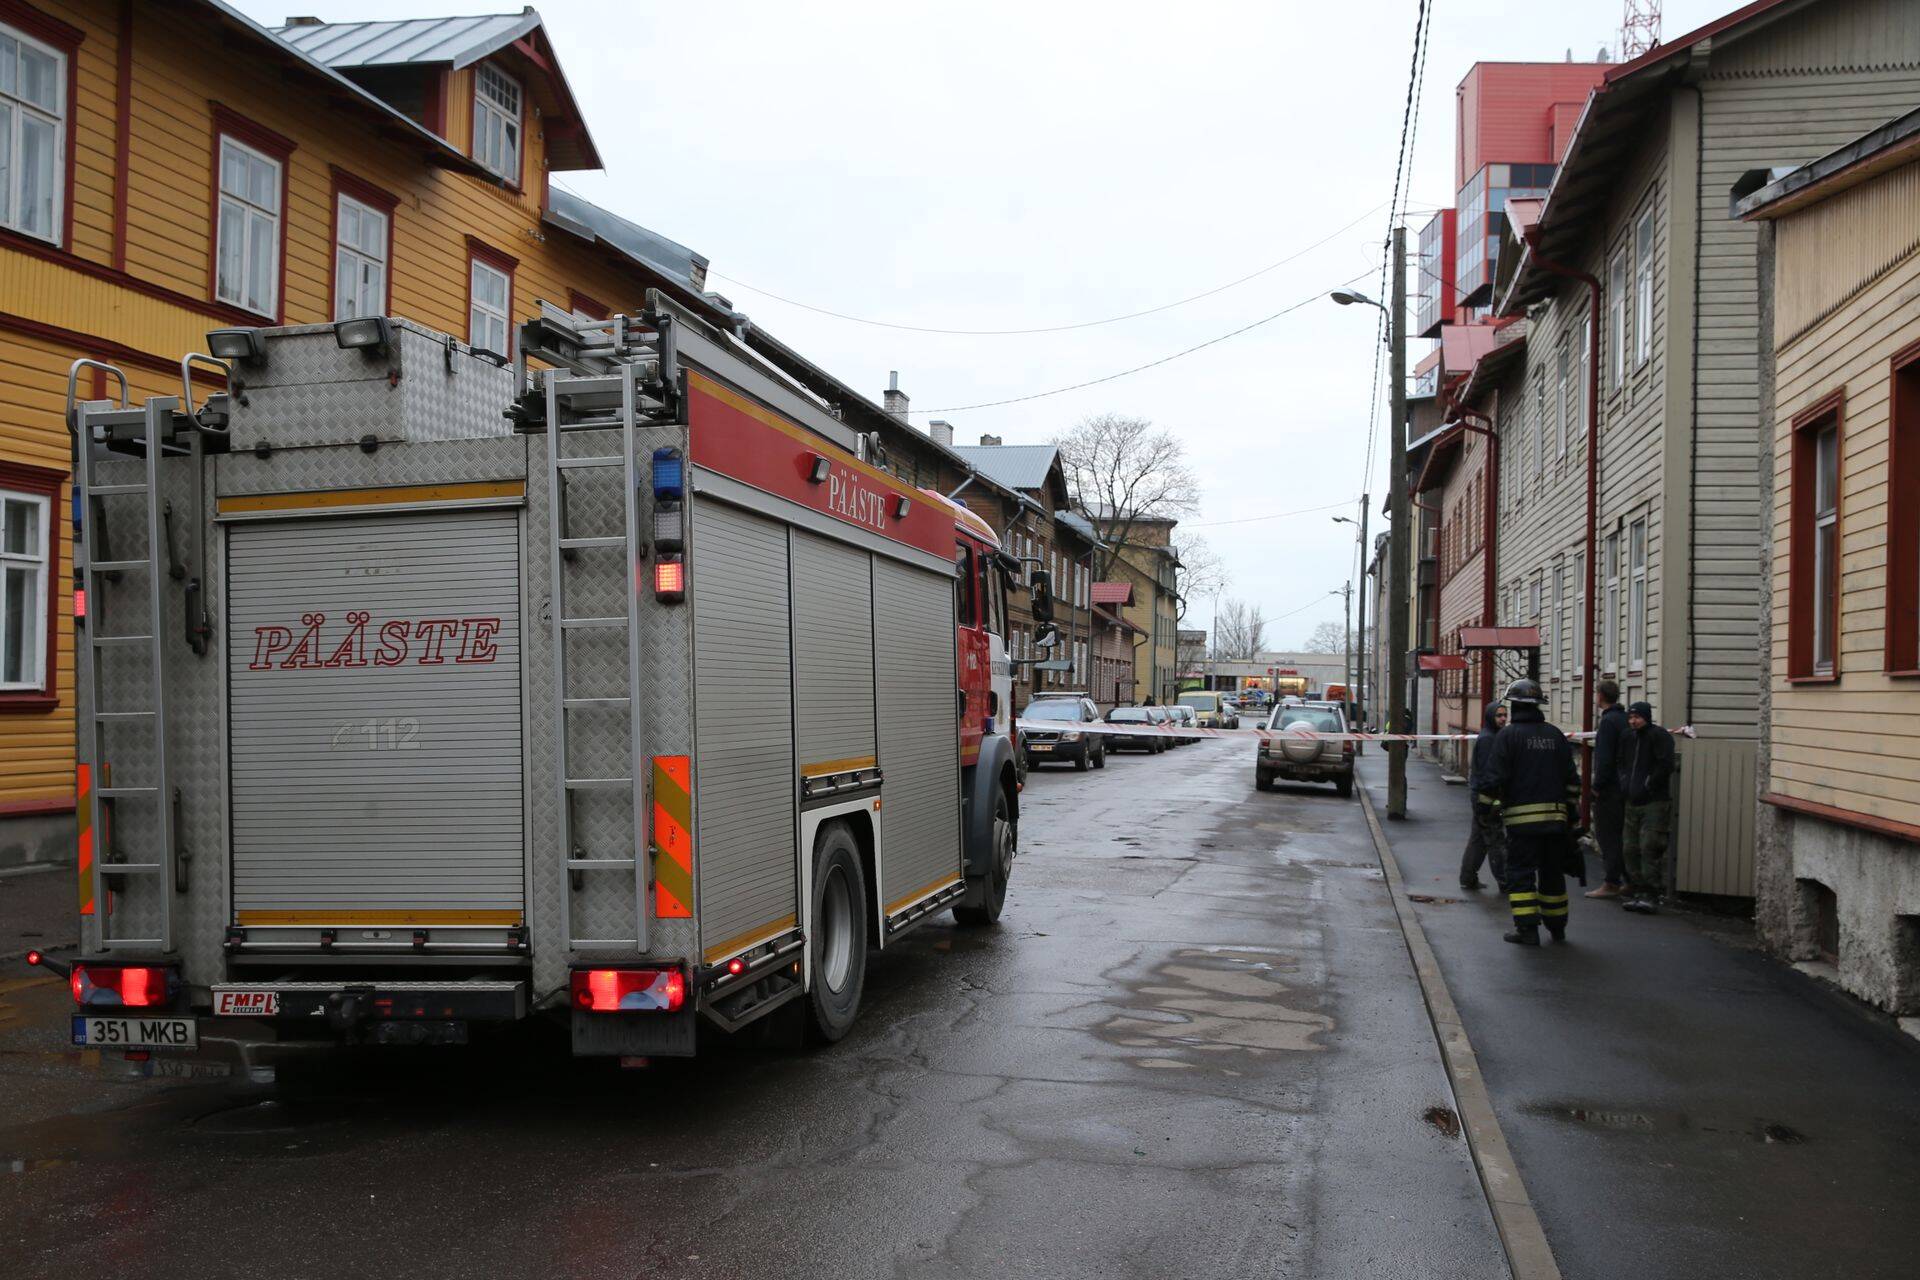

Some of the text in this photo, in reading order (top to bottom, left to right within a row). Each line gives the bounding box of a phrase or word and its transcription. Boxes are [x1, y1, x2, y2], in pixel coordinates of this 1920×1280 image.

[829, 469, 885, 529] PÄÄSTE
[250, 612, 500, 669] PÄÄSTE
[360, 718, 421, 751] 112
[220, 993, 274, 1013] EMPL
[93, 1020, 188, 1043] 351 MKB
